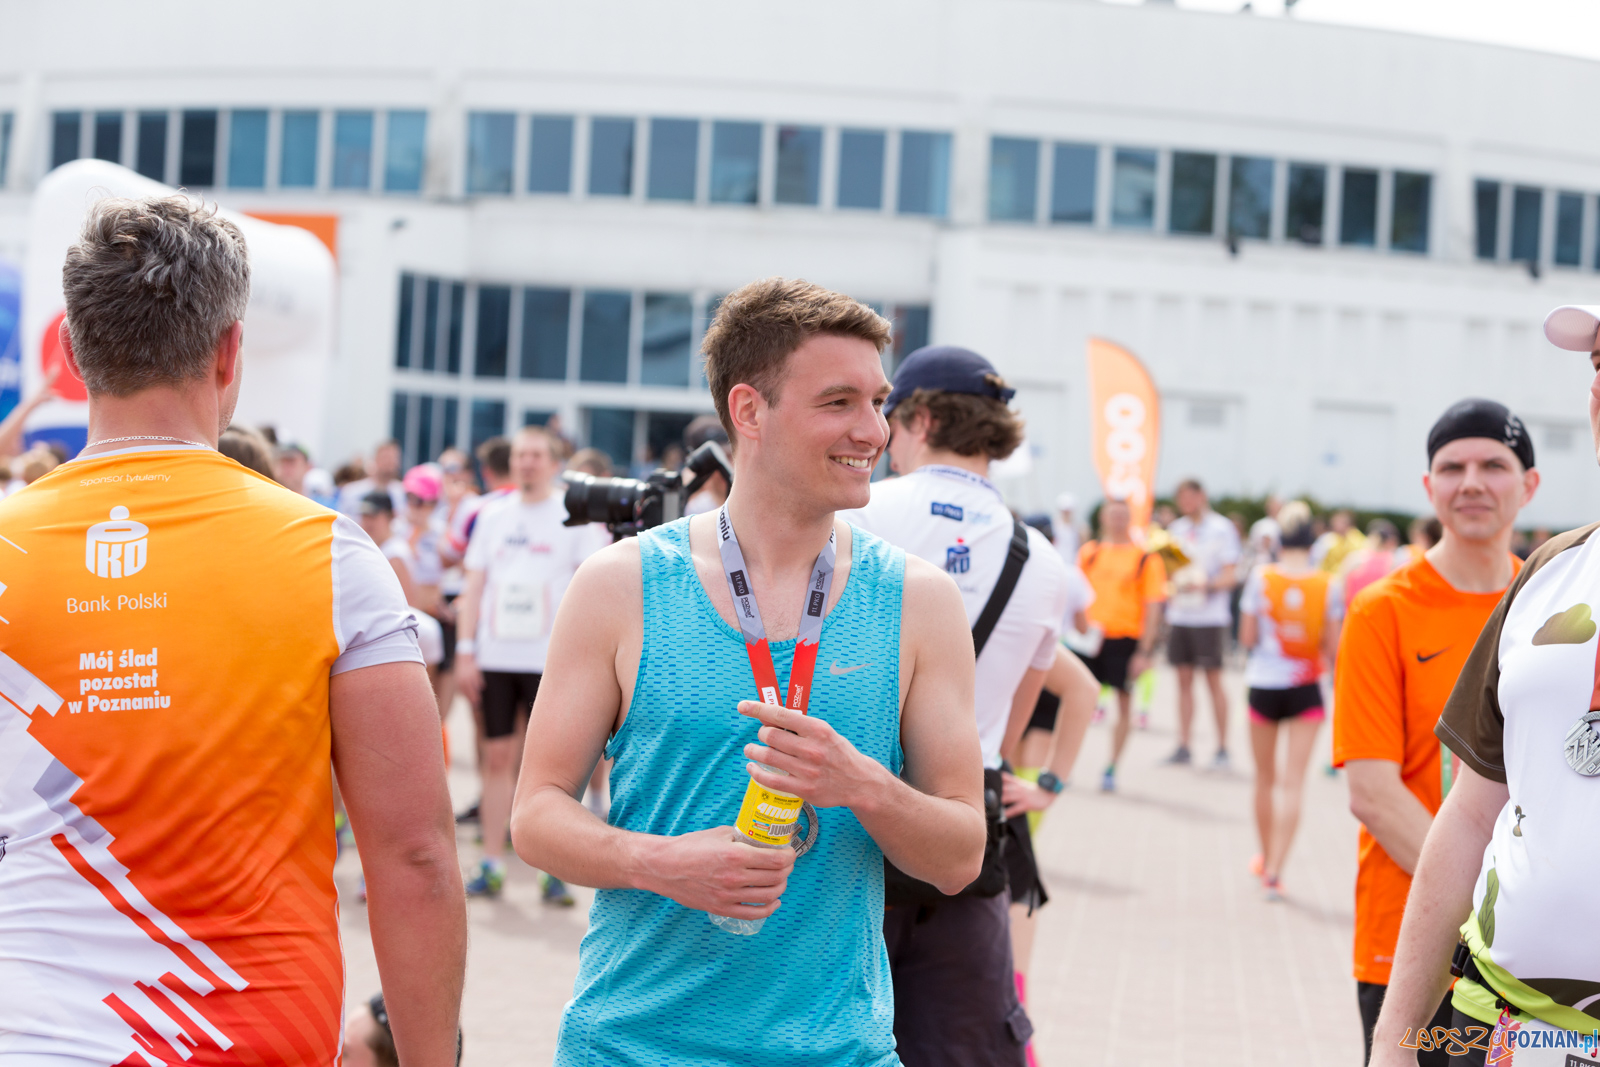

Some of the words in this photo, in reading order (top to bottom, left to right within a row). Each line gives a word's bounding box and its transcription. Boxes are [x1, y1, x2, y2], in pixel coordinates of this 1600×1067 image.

[125, 473, 171, 483] tytularny
[66, 595, 111, 613] Bank
[117, 592, 168, 610] Polski
[79, 650, 113, 672] Mój
[119, 647, 158, 668] ślad
[79, 669, 158, 695] pozostał
[68, 701, 82, 714] w
[87, 690, 171, 713] Poznaniu
